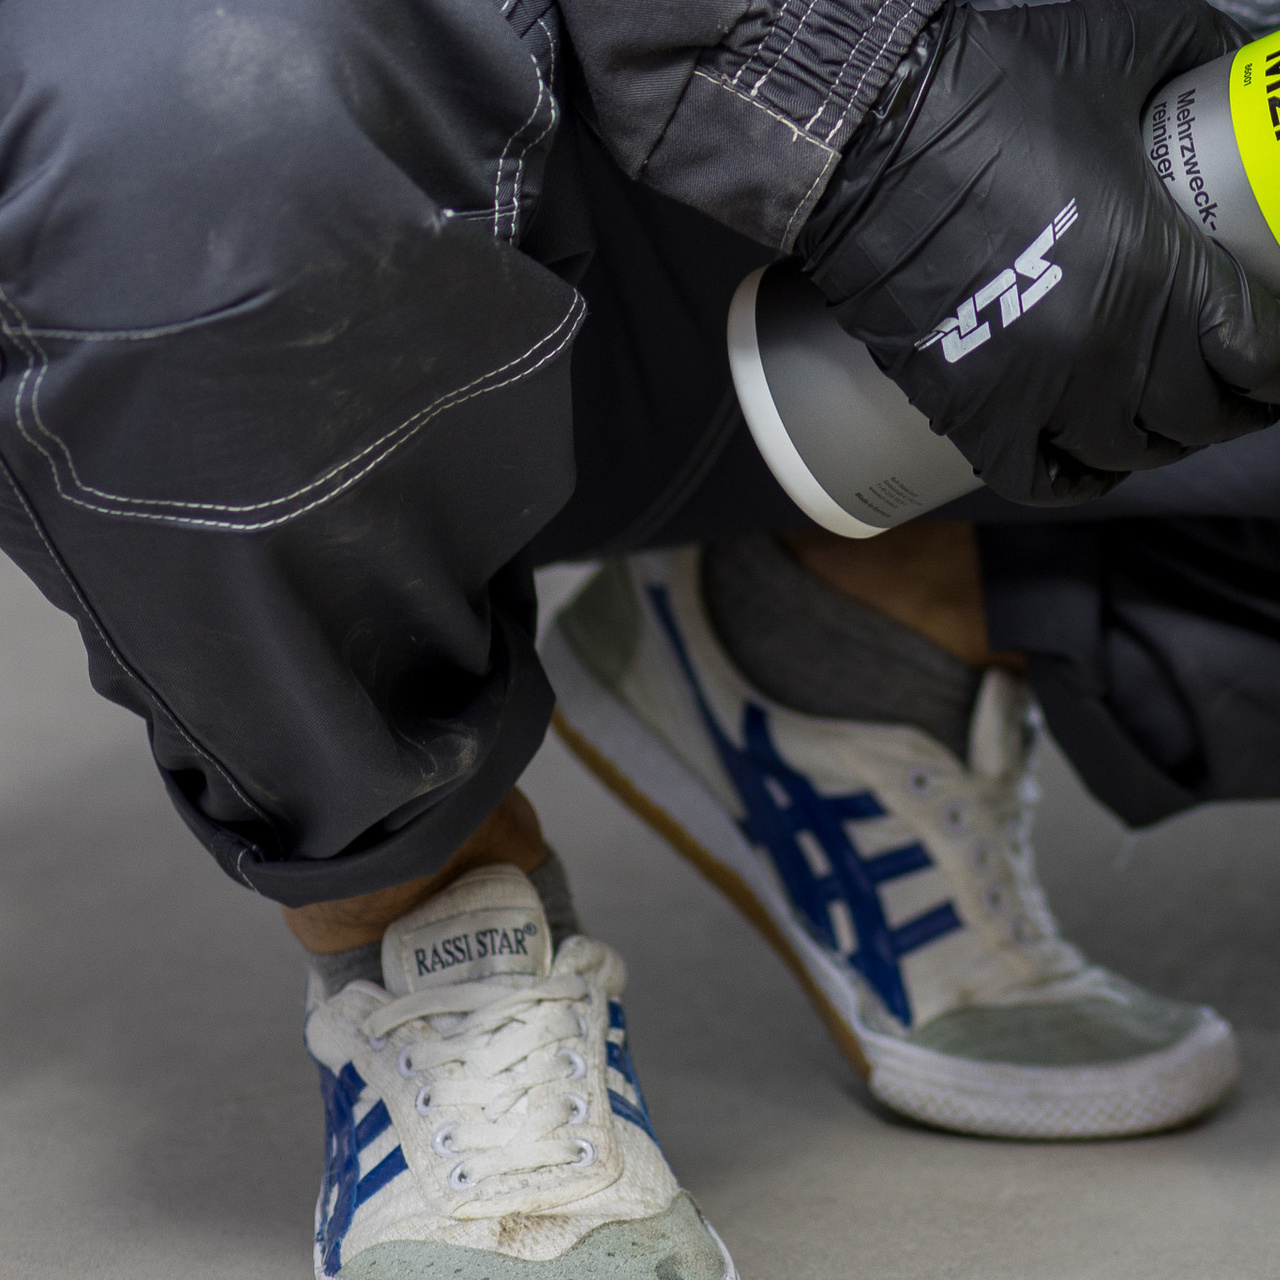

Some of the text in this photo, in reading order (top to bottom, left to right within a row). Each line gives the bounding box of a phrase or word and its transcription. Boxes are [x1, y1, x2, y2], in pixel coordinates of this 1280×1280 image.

[1243, 62, 1254, 88] 86001
[1150, 100, 1176, 182] reiniger
[1176, 88, 1219, 232] Mehrzweck-
[414, 933, 473, 977] RASSI
